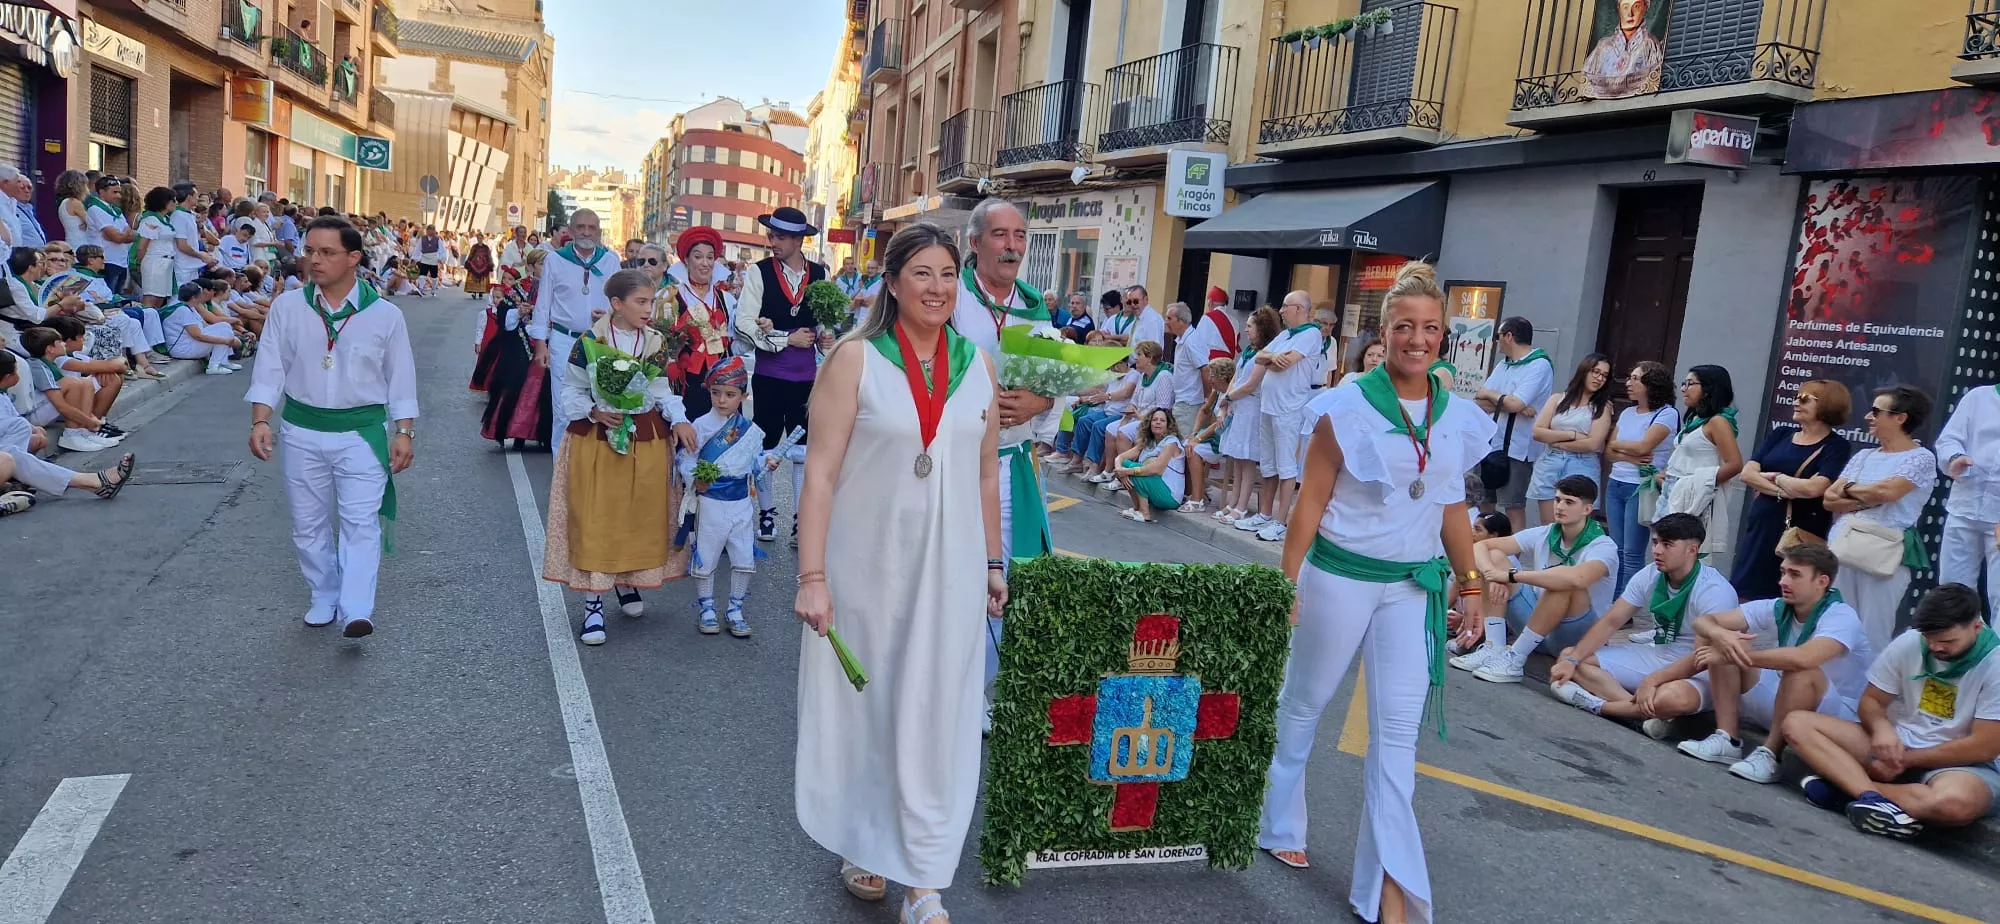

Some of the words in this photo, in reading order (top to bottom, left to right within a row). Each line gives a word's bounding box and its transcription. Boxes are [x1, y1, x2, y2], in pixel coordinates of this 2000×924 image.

[1643, 169, 1656, 181] 60
[1176, 187, 1216, 202] Aragón
[1030, 198, 1067, 224] Aragón
[1068, 197, 1103, 218] Fincas
[1177, 200, 1211, 212] Fincas
[1353, 230, 1378, 250] quka
[1789, 319, 1842, 332] Perfumes
[1845, 322, 1860, 333] de
[1863, 323, 1945, 338] Equivalencia
[1786, 337, 1833, 349] Jabones
[1836, 339, 1898, 353] Artesanos
[1783, 351, 1871, 367] Ambientadores
[1781, 366, 1812, 377] Geles
[1035, 852, 1060, 863] REAL
[1063, 851, 1115, 862] COFRADIA
[1118, 851, 1131, 860] DE
[1134, 849, 1156, 859] SAN
[1158, 847, 1203, 858] LORENZO
